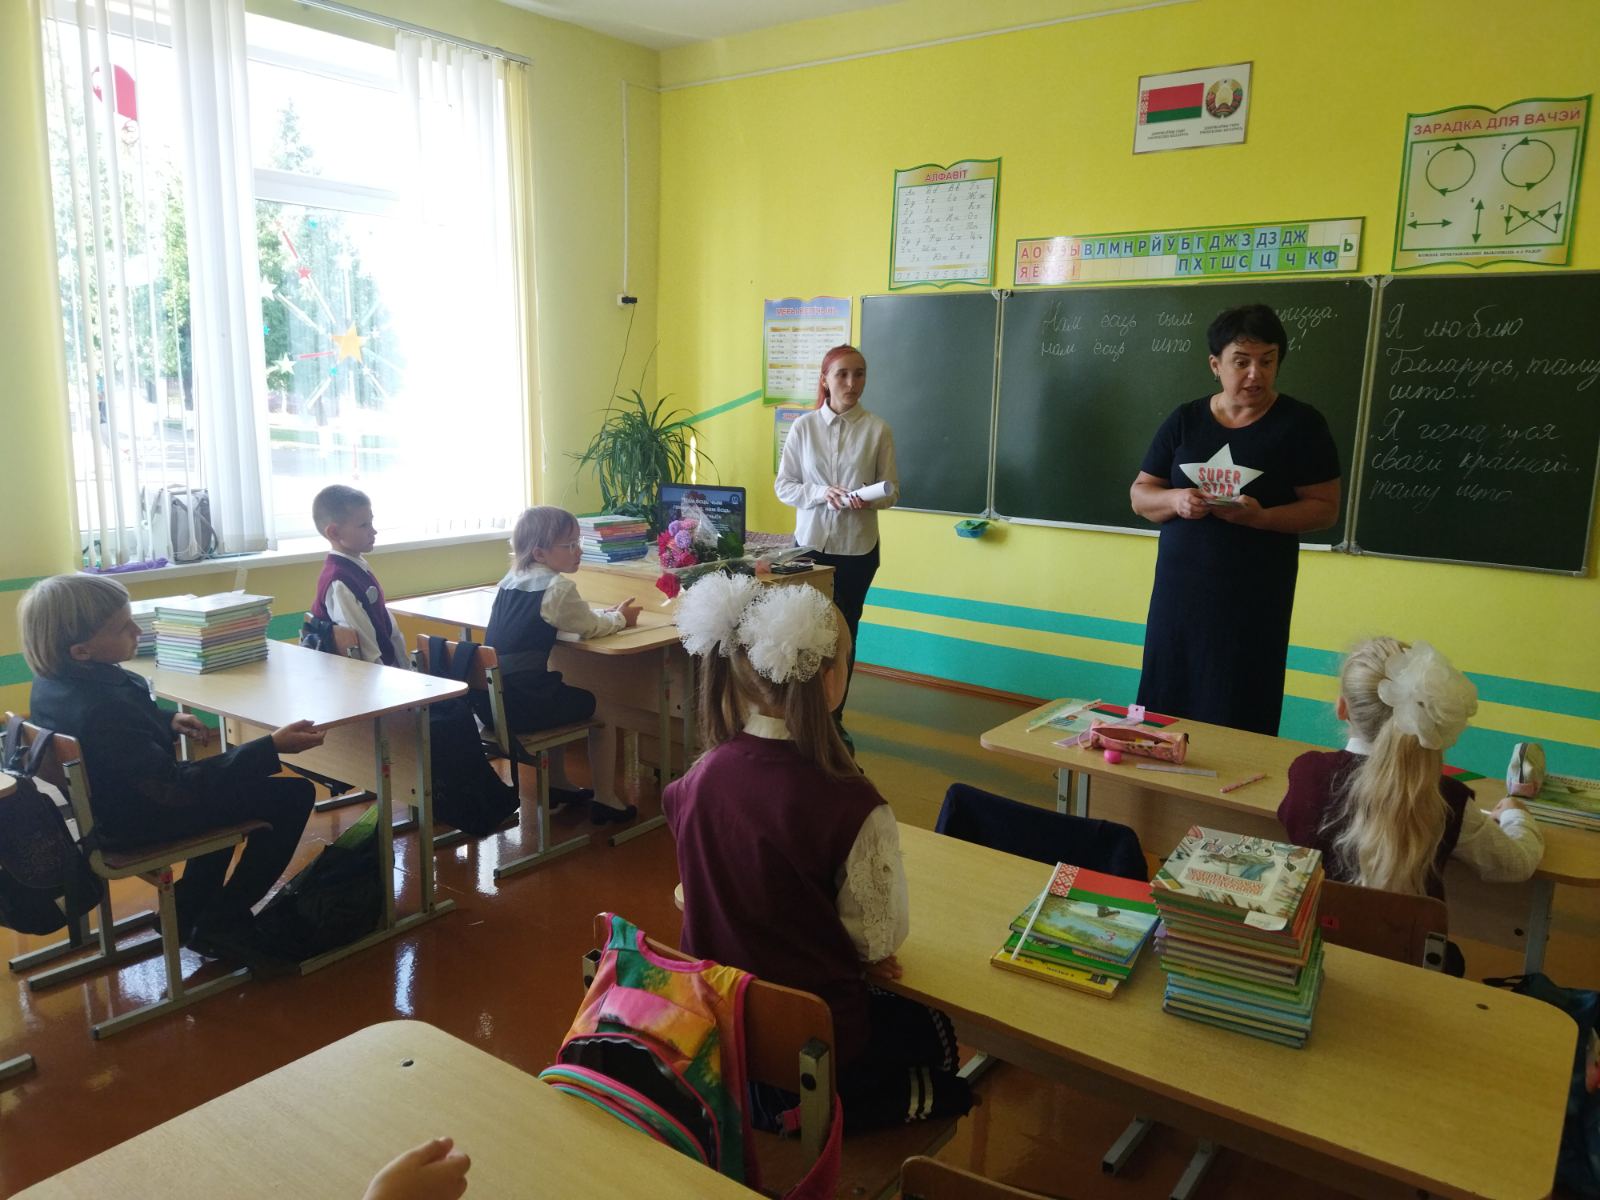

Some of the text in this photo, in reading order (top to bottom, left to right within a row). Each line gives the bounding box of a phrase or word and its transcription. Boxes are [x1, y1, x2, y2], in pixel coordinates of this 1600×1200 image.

[1413, 108, 1581, 136] ЗАРАДКА ДЛЯ ВАЧЭЙ
[925, 170, 968, 182] АЛФАВІТ
[1386, 304, 1523, 338] Я люблю
[1198, 467, 1242, 484] SUPER
[1201, 481, 1235, 498] STAR
